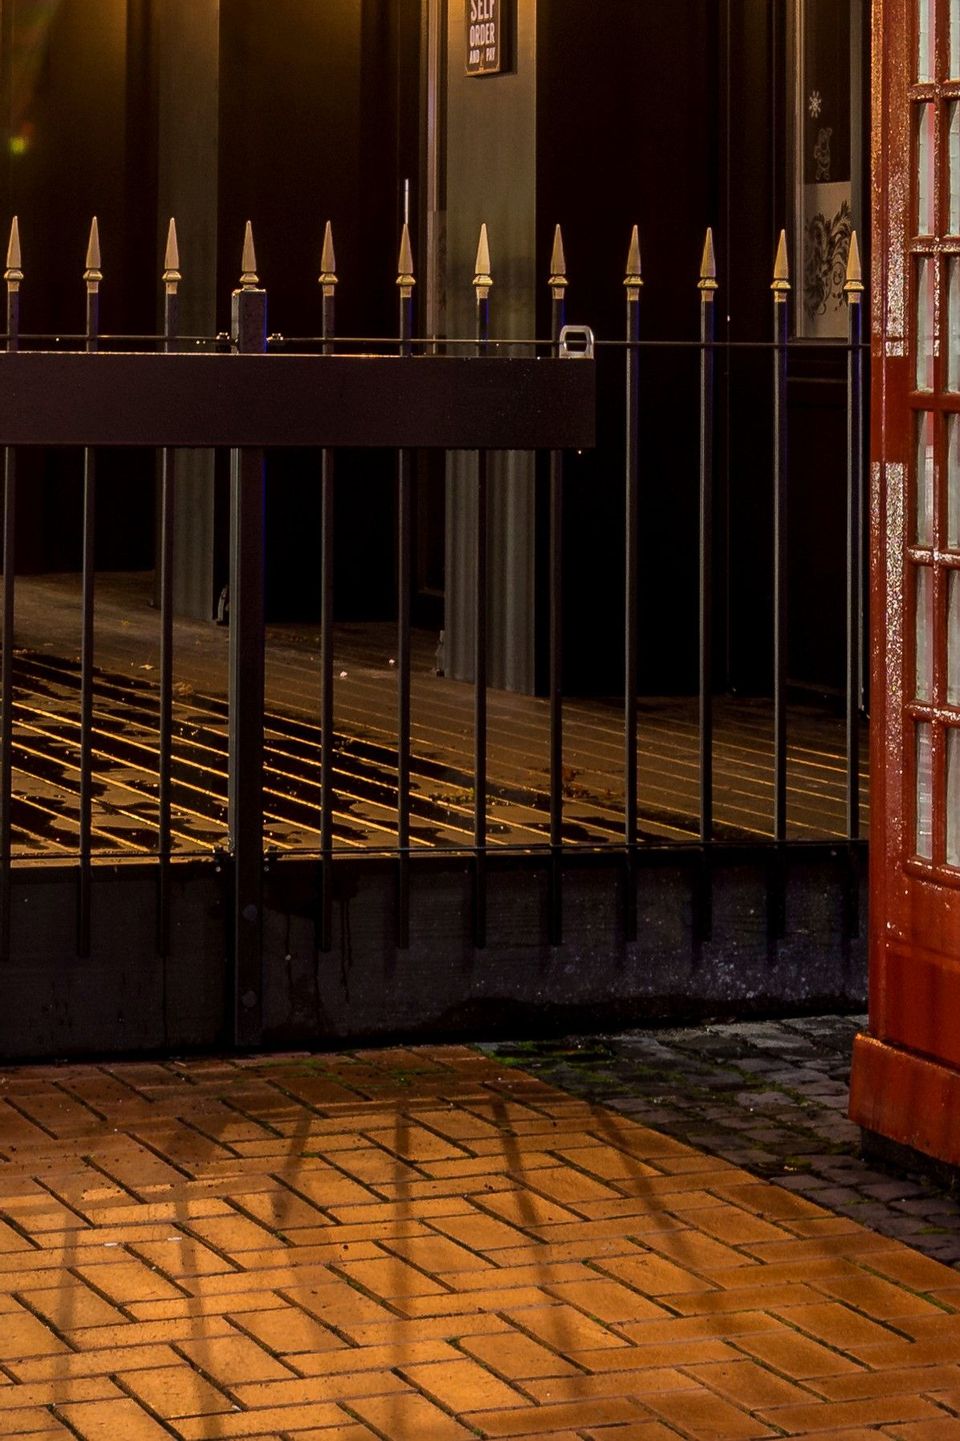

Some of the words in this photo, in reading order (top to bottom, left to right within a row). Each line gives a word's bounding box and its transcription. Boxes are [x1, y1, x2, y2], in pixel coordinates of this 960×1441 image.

[469, 22, 496, 48] ORDER
[469, 49, 480, 65] AND
[485, 47, 496, 62] PAY
